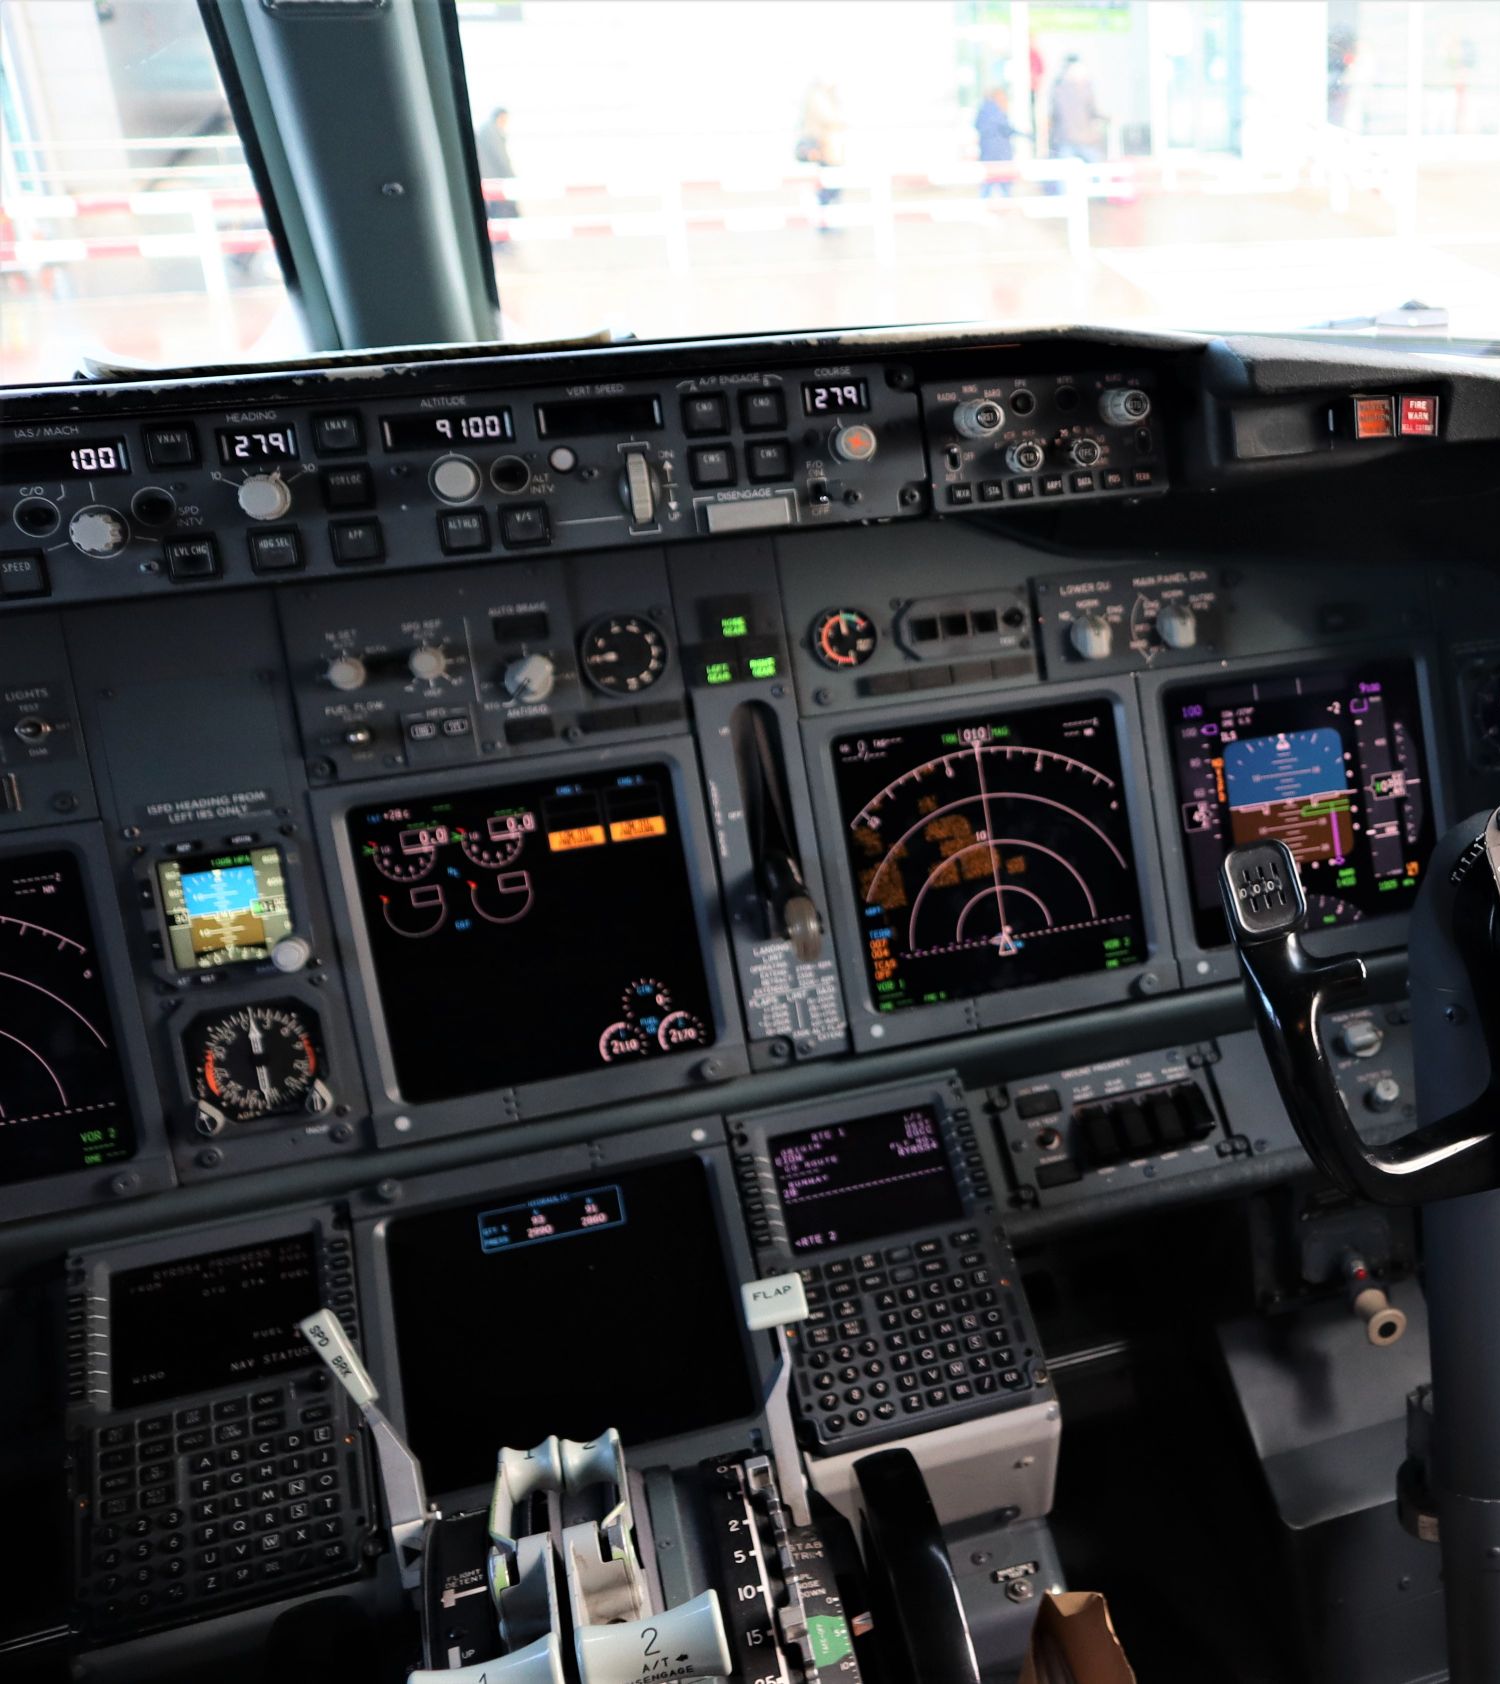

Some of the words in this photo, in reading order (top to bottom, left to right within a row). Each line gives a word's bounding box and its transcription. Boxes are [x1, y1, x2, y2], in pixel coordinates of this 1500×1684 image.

[814, 366, 852, 378] COURSE
[718, 372, 761, 386] ENGAGE
[595, 383, 626, 396] SPEED
[420, 395, 467, 408] ALTITUDE
[814, 385, 858, 408] 279
[1409, 400, 1427, 409] FIRE
[225, 410, 278, 424] HEADING
[1407, 412, 1429, 421] WARN
[155, 432, 183, 445] VNAV
[234, 432, 288, 458] 279
[70, 447, 117, 471] 100
[302, 462, 316, 474] 30
[210, 470, 223, 482] 10
[532, 473, 550, 483] ALT
[19, 485, 44, 497] C/O
[717, 486, 772, 500] DISENGAGE
[178, 505, 200, 517] SPD
[177, 516, 204, 527] INTV
[1, 561, 32, 574] SPEED
[1059, 582, 1095, 597] LOWER
[4, 687, 49, 702] LIGHTS
[963, 727, 985, 741] 010
[146, 803, 173, 817] ISFD
[176, 793, 231, 813] HEADING
[232, 789, 268, 803] FROM
[168, 811, 194, 826] LEFT
[216, 804, 249, 819] ONLY
[668, 1028, 697, 1044] 2170
[610, 1039, 639, 1054] 2110
[929, 1282, 940, 1294] C
[953, 1277, 963, 1288] D
[752, 1285, 792, 1301] FLAP
[883, 1295, 893, 1304] A
[911, 1308, 922, 1319] G
[987, 1311, 998, 1322] O
[309, 1324, 329, 1347] SPD
[331, 1355, 353, 1379] BRK
[865, 1342, 874, 1352] 3
[921, 1349, 934, 1360] Q
[977, 1358, 986, 1367] X
[903, 1375, 914, 1386] U
[928, 1370, 937, 1379] V
[856, 1410, 865, 1421] 0
[716, 1465, 729, 1474] 0
[728, 1520, 740, 1532] 2
[733, 1550, 747, 1564] 5
[793, 1550, 824, 1560] TRIM
[444, 1574, 484, 1589] DETENT
[446, 1568, 481, 1583] FLIGHT
[738, 1585, 756, 1601] 10
[641, 1626, 661, 1657] 2
[746, 1630, 764, 1646] 15
[461, 1649, 476, 1659] UP
[642, 1656, 669, 1674] A/T
[840, 1661, 850, 1671] 10
